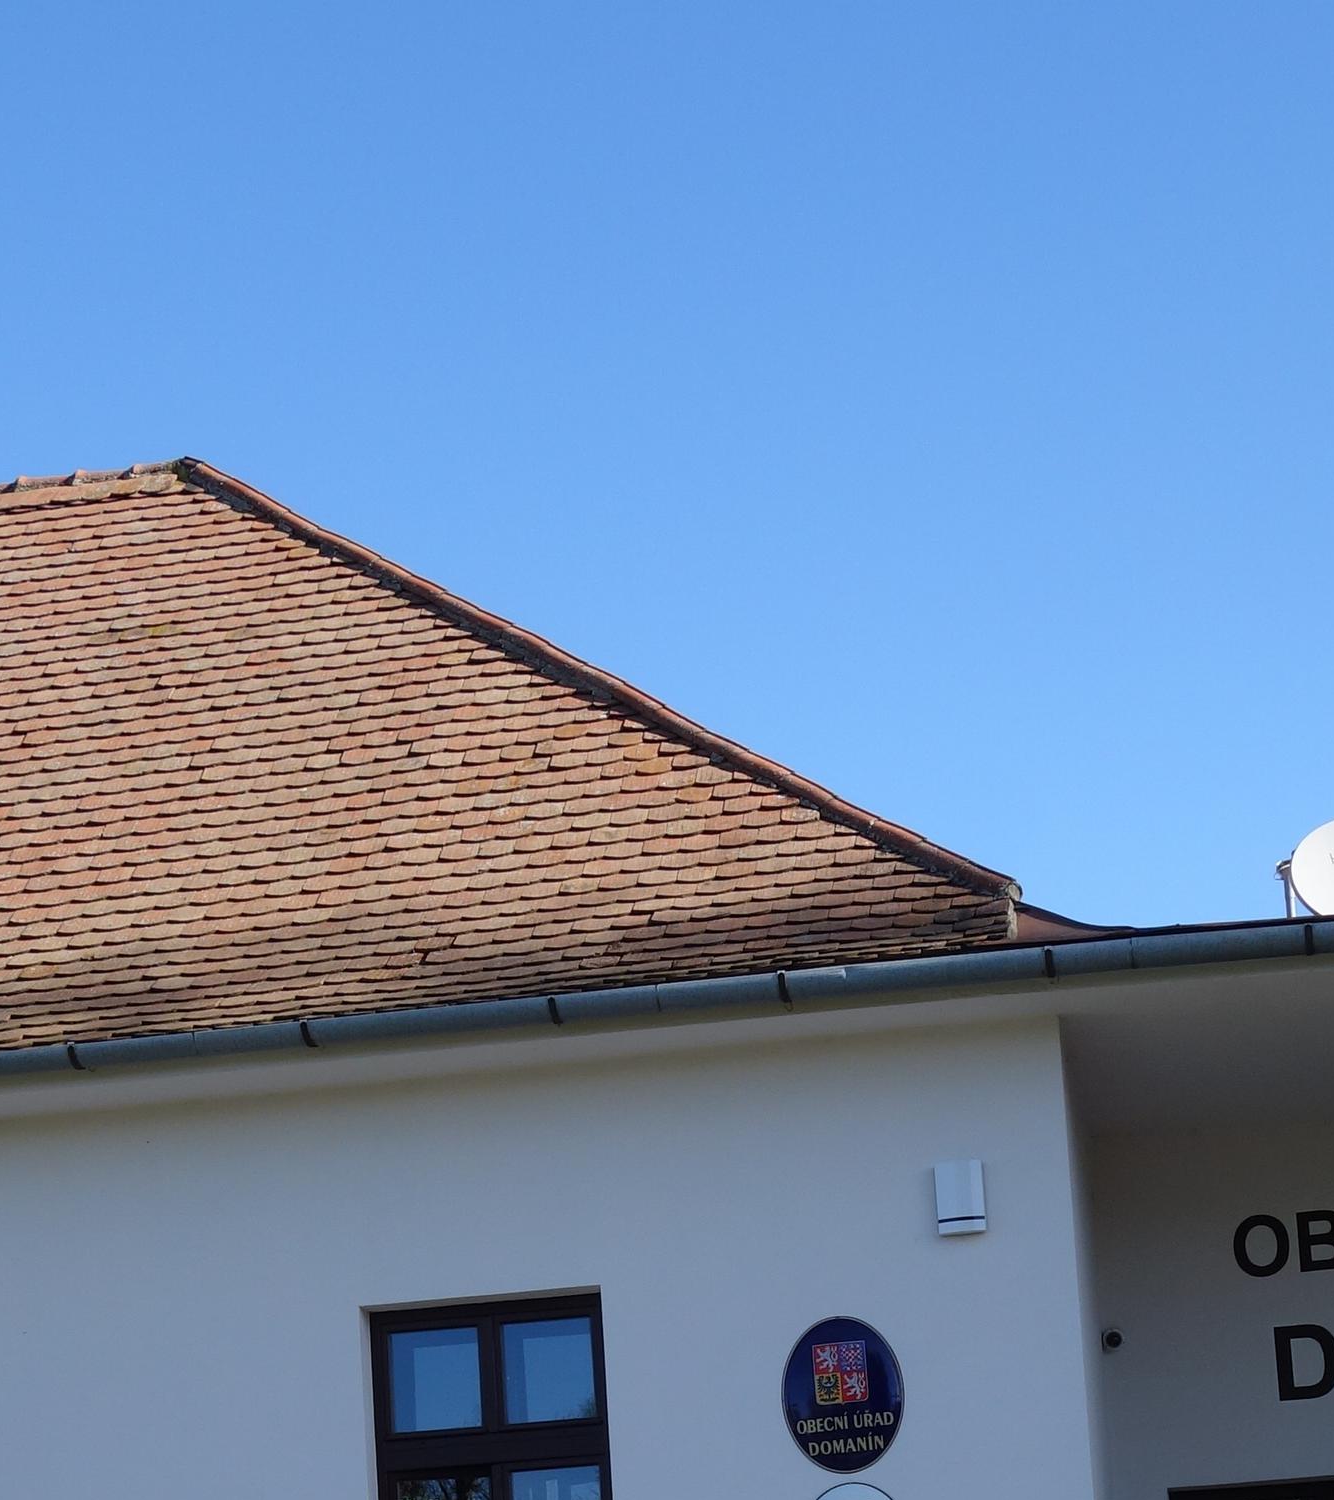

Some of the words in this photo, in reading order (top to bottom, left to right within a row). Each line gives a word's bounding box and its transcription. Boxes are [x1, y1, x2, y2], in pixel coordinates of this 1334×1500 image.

[796, 1411, 849, 1435] OBECNÍ
[853, 1409, 895, 1429] ÚŘAD
[808, 1431, 885, 1457] DOMANÍN
